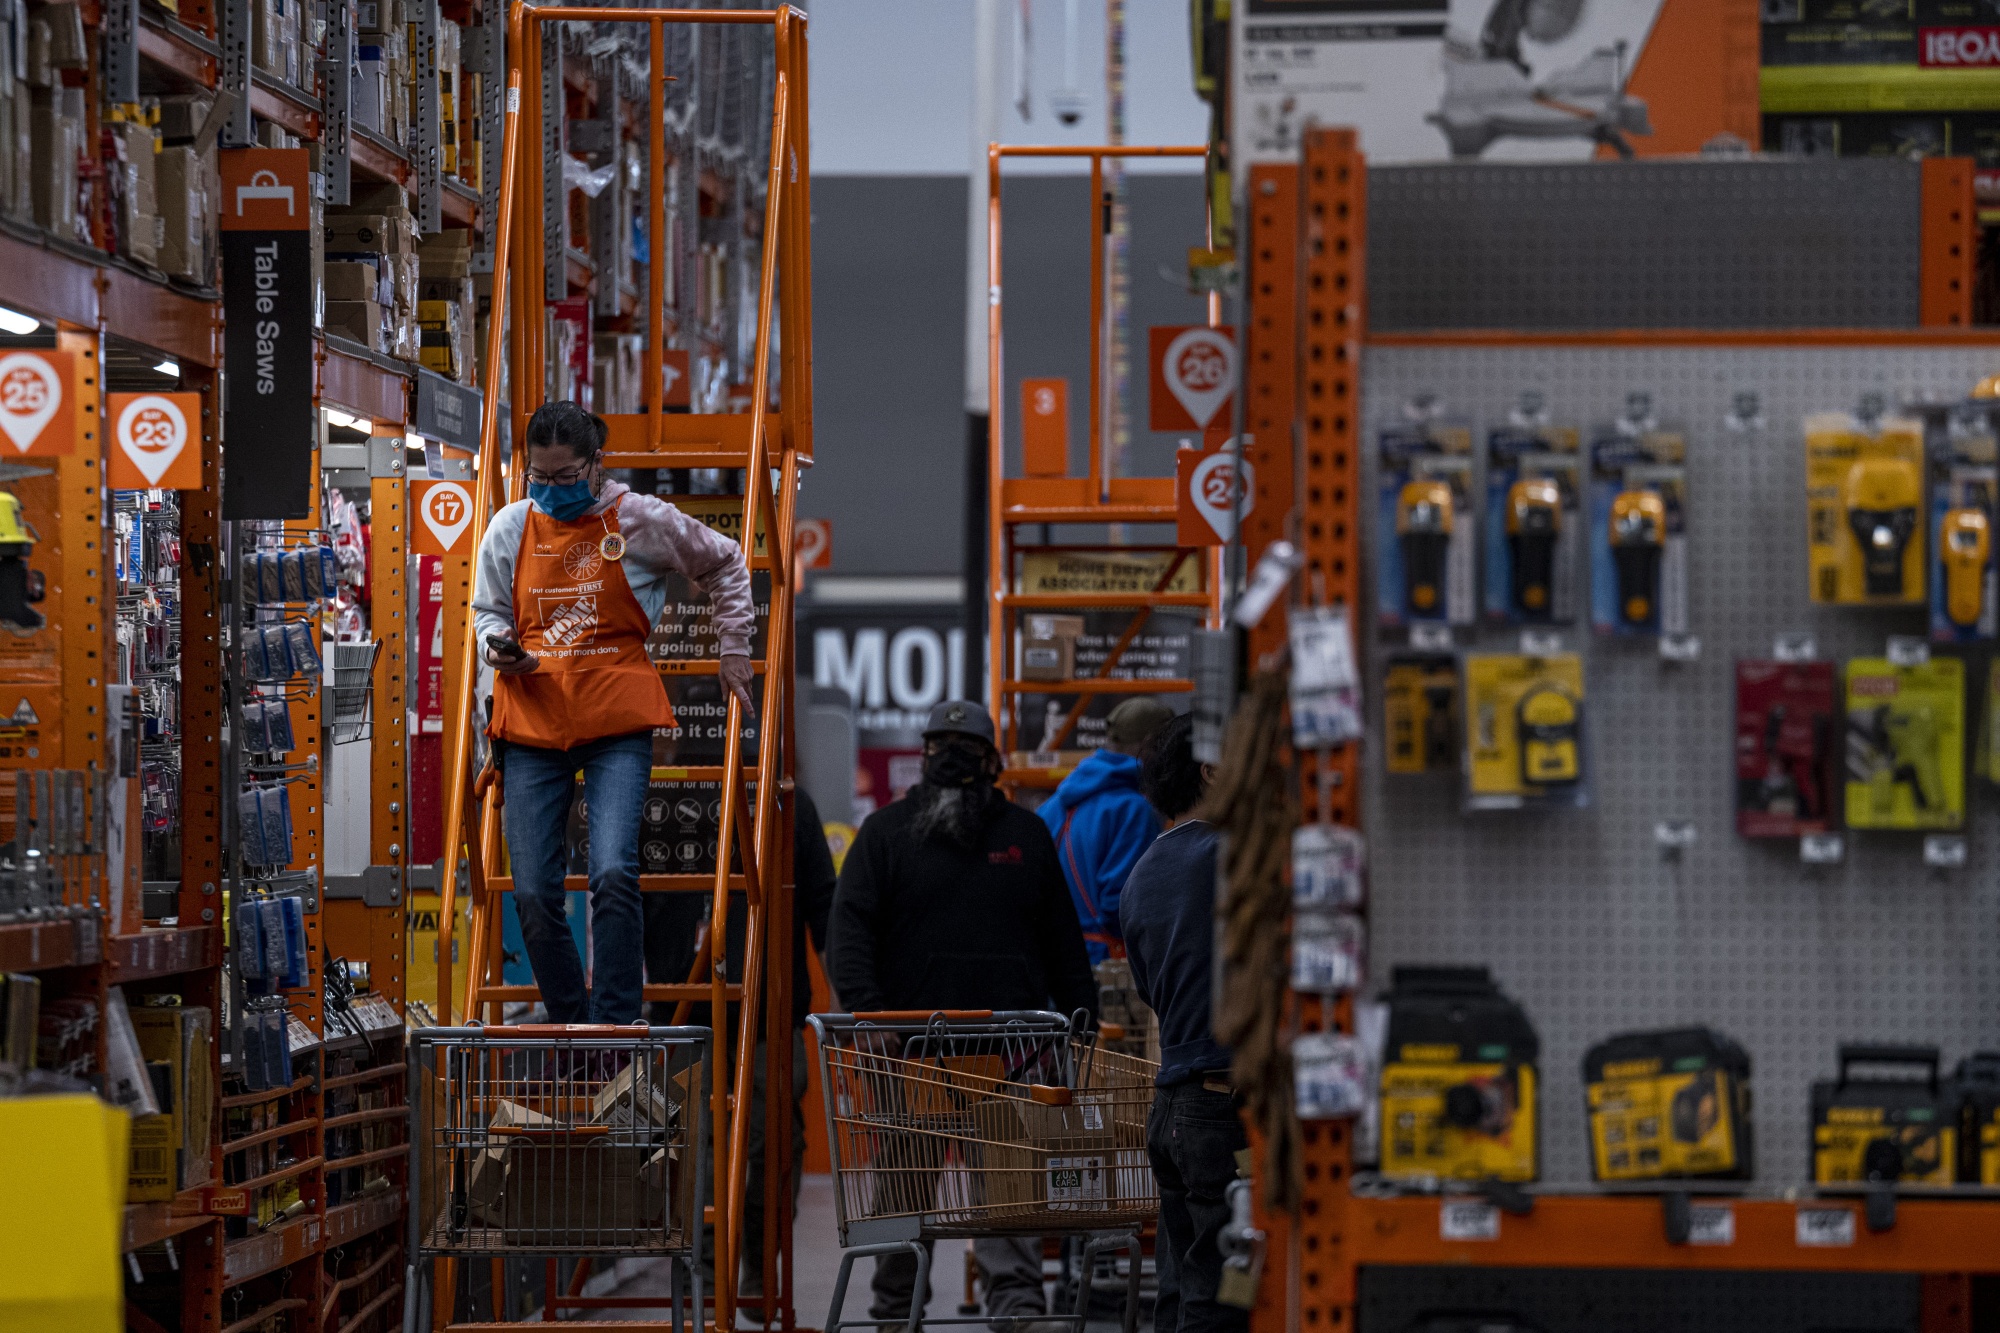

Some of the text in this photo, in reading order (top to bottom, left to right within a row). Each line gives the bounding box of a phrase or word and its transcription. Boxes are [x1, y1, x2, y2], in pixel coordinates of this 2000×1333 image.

[255, 241, 280, 394] Table Saws
[1181, 356, 1223, 384] 26
[4, 381, 46, 409] 25
[142, 412, 162, 420] BAY
[135, 421, 175, 447] 23
[439, 493, 454, 501] BAY
[434, 501, 461, 521] 17
[578, 583, 603, 593] FIRST
[1039, 577, 1139, 590] ASSOCIATES
[548, 603, 570, 621] THE
[543, 596, 596, 646] HOME
[561, 615, 598, 646] DEPOT
[538, 648, 558, 657] doers
[558, 648, 572, 659] get
[573, 648, 596, 656] more
[597, 645, 621, 654] done.
[659, 641, 705, 657] going
[688, 723, 702, 738] it
[211, 1193, 245, 1209] new!
